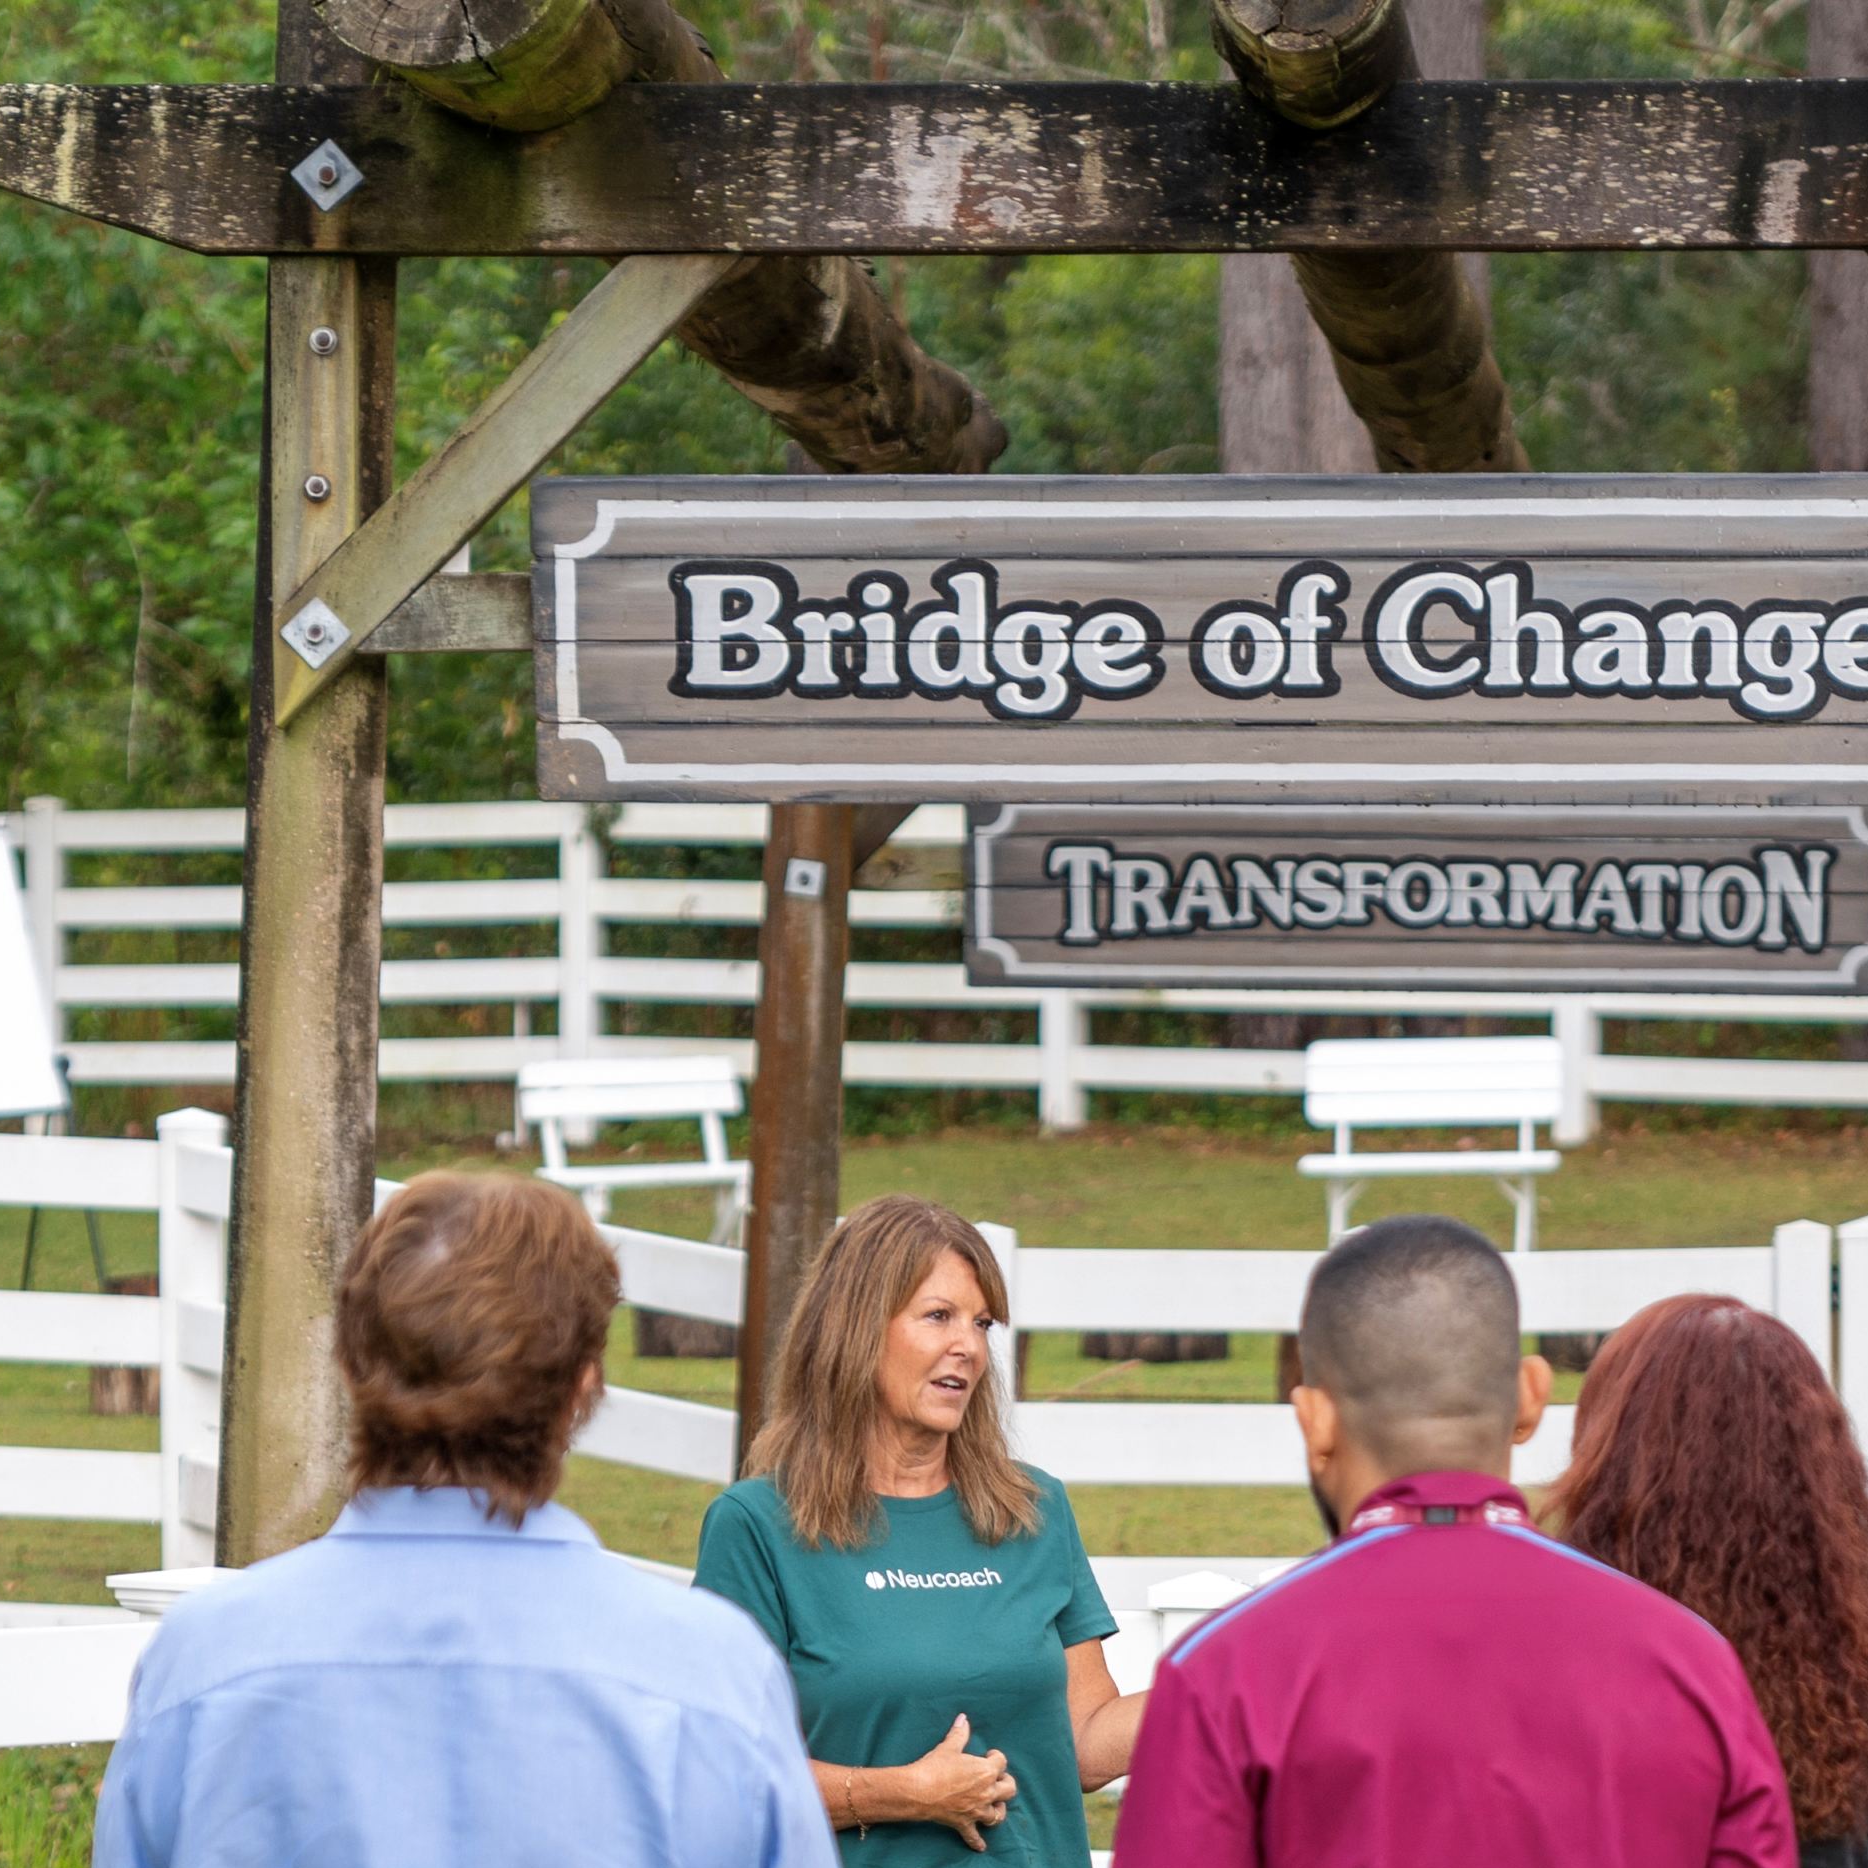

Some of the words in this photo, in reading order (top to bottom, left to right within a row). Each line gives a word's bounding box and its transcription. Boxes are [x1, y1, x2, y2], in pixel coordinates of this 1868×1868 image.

[684, 571, 1152, 715] Bridge
[1201, 573, 1337, 688] of
[1046, 845, 1830, 946] TRANSFORMATION
[885, 1567, 1003, 1589] Neucoach
